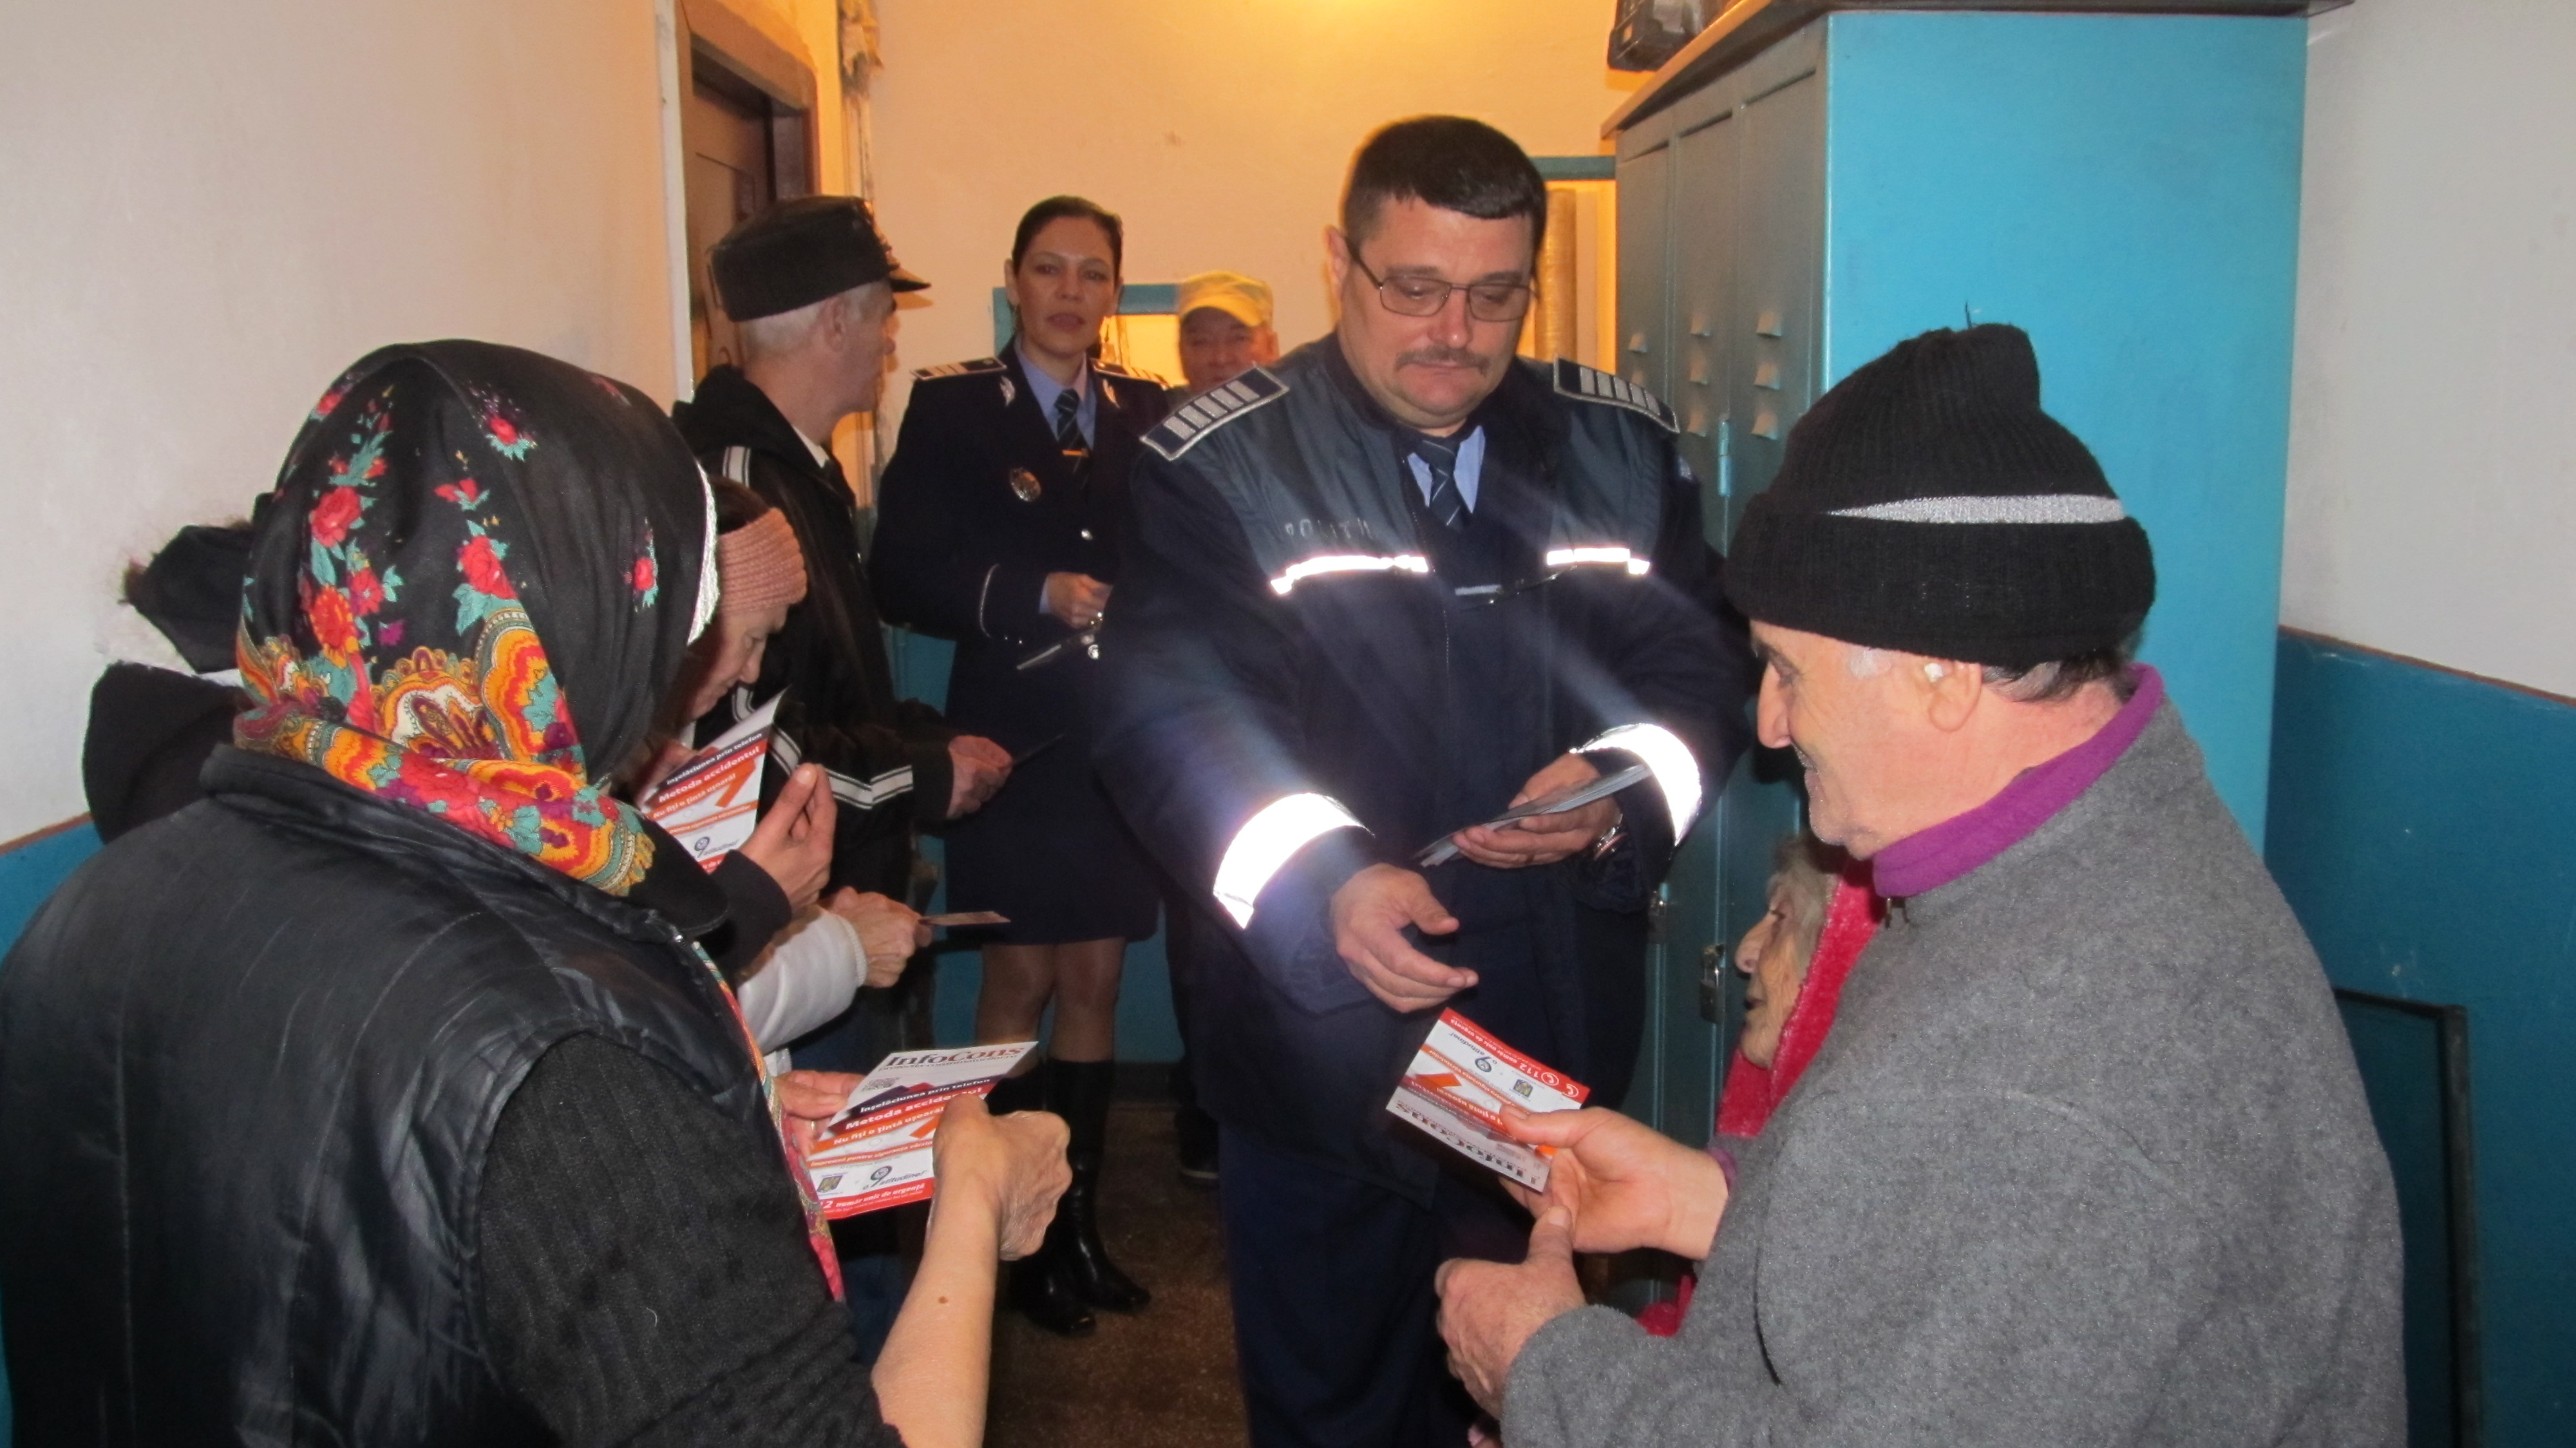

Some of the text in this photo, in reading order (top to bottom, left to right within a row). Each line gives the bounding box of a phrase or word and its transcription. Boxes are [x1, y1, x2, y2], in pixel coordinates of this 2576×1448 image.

[734, 733, 762, 750] telefon
[659, 746, 760, 803] Metoda accidentul
[886, 1047, 1025, 1067] InfoCons
[1519, 1063, 1540, 1078] 112
[927, 1086, 950, 1096] prin
[952, 1079, 991, 1090] telefon
[845, 1087, 983, 1130] Metoda accideul
[833, 1137, 849, 1145] Nu
